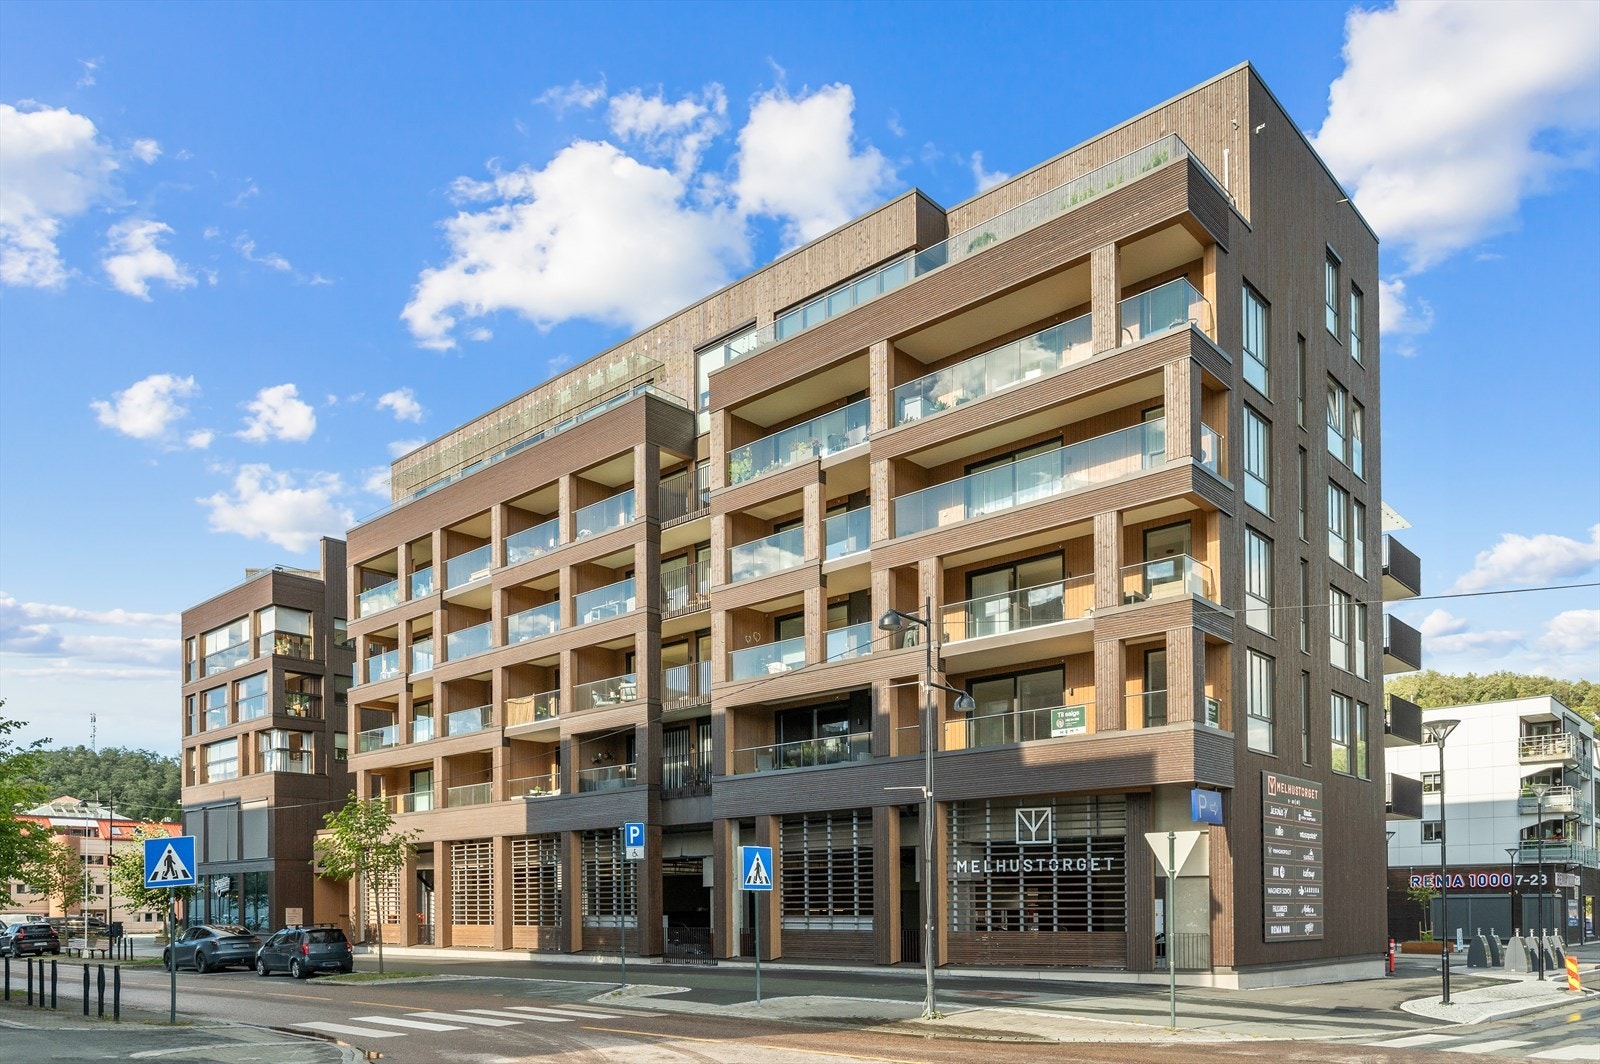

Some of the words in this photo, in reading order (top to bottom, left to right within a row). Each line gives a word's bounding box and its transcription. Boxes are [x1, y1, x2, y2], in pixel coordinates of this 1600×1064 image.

[1276, 781, 1318, 800] MELHUSTORGET
[1198, 794, 1207, 818] P
[630, 825, 640, 844] P
[957, 857, 1114, 873] MELHUSTORGET
[1410, 873, 1465, 888] REMA
[1469, 873, 1513, 888] 1000
[1515, 874, 1548, 886] 7-23
